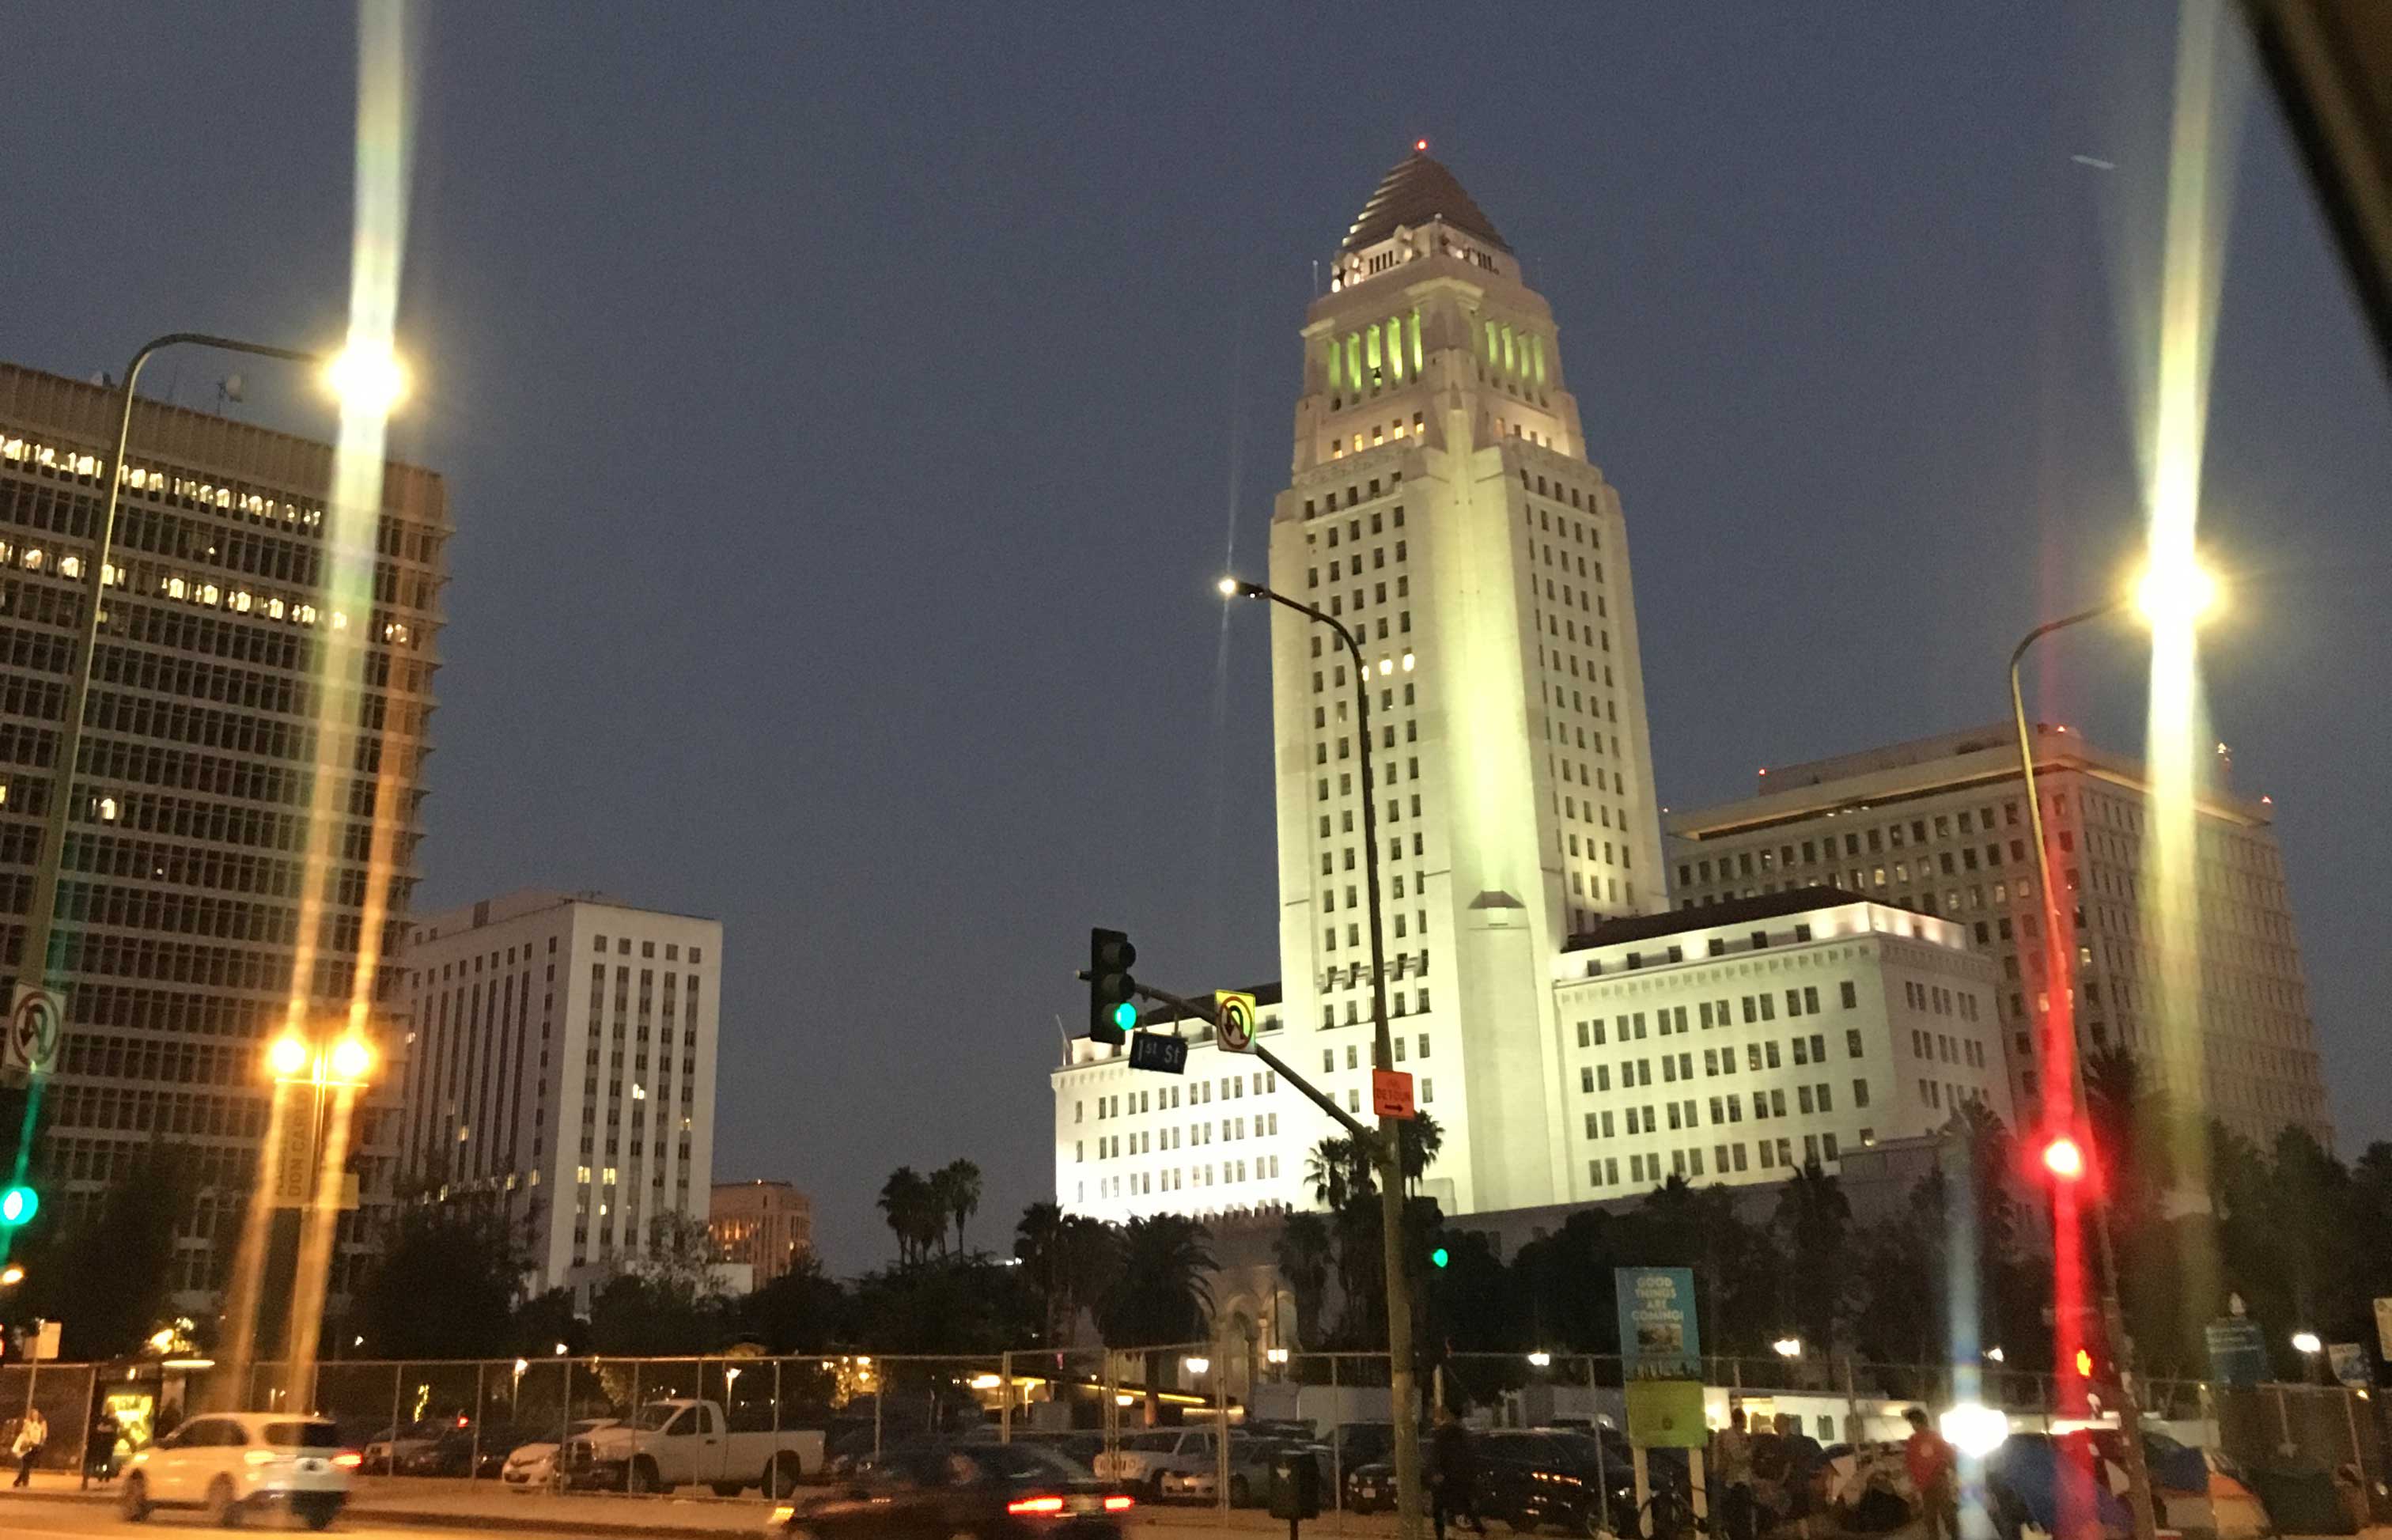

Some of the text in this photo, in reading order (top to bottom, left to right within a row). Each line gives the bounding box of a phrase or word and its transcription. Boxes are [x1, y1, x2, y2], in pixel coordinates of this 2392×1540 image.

[1137, 1039, 1180, 1064] 1st St
[1376, 1088, 1412, 1102] DETOUR
[287, 1158, 304, 1197] DON
[1636, 1277, 1673, 1288] GOOD
[1634, 1288, 1676, 1299] THINGS
[1646, 1300, 1667, 1310] ARE
